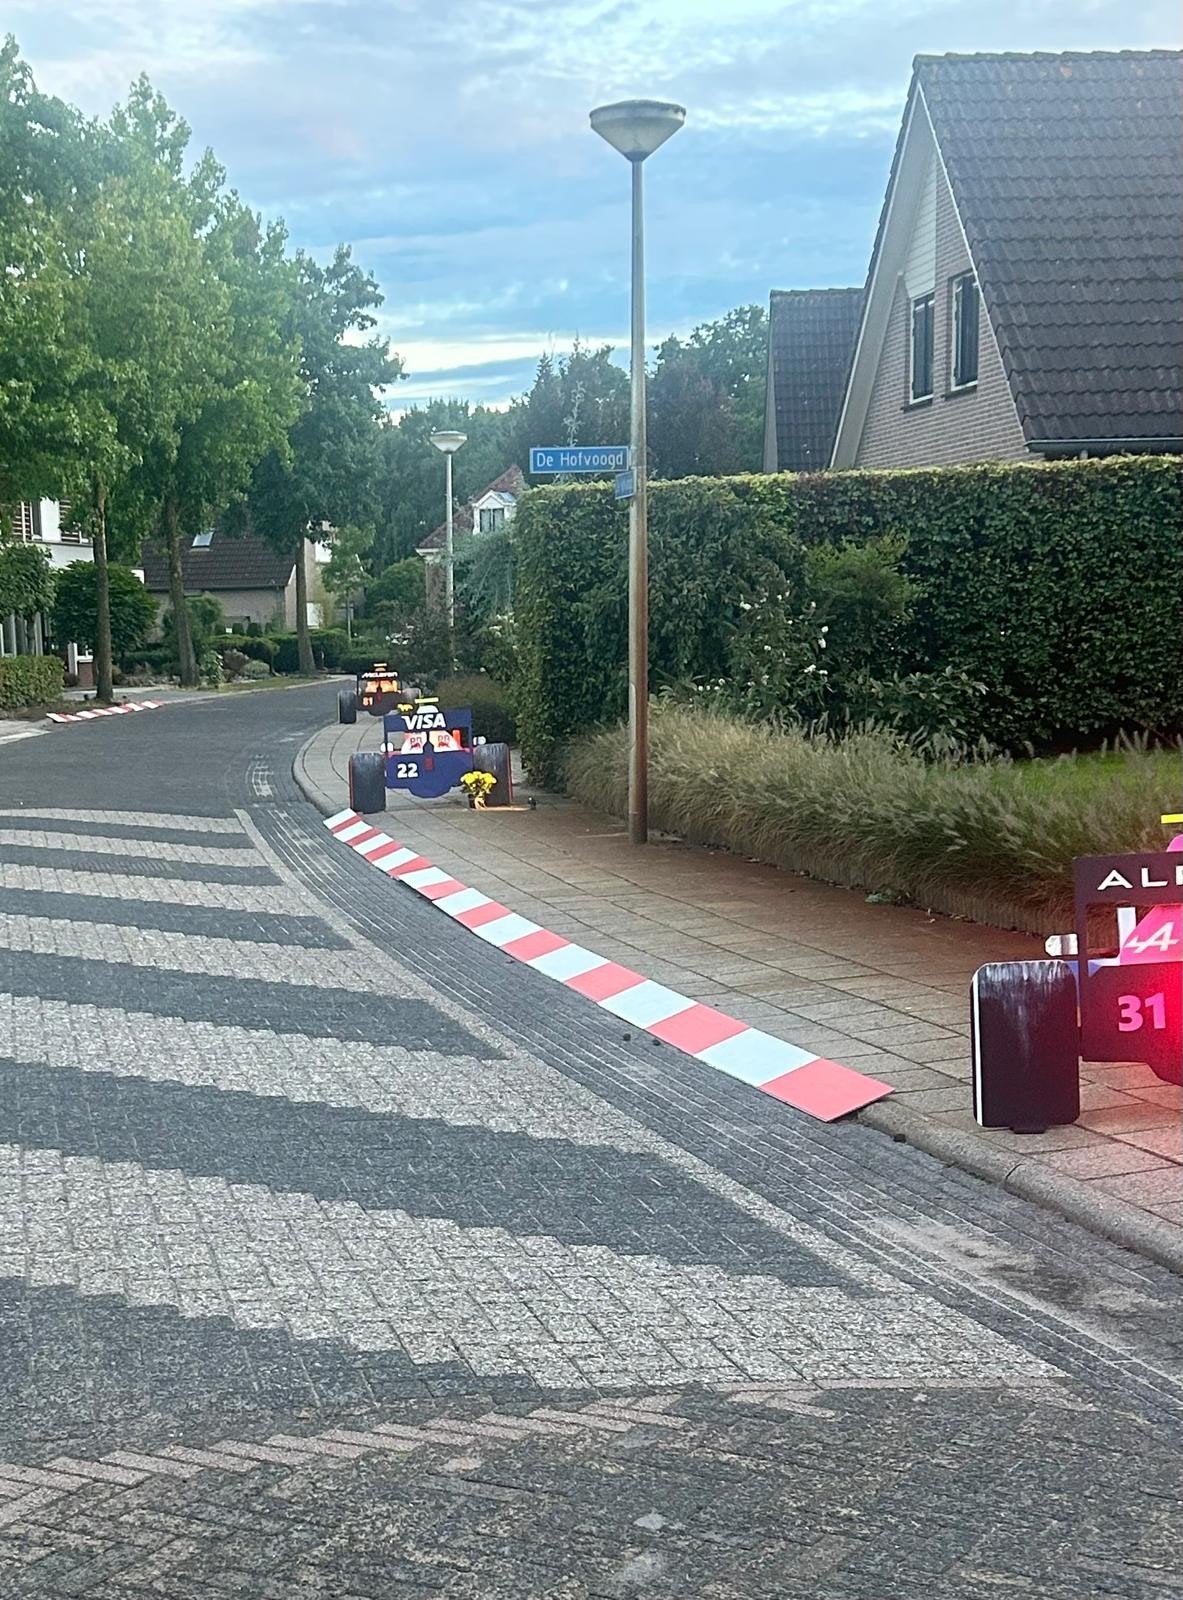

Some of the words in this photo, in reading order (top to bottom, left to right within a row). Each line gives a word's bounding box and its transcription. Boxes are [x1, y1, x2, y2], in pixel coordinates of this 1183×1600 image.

[536, 452, 553, 467] De
[560, 450, 623, 469] Hofvoogd
[401, 713, 446, 730] VISA
[397, 763, 418, 779] 22
[1097, 864, 1183, 890] AL
[1117, 992, 1167, 1032] 31
